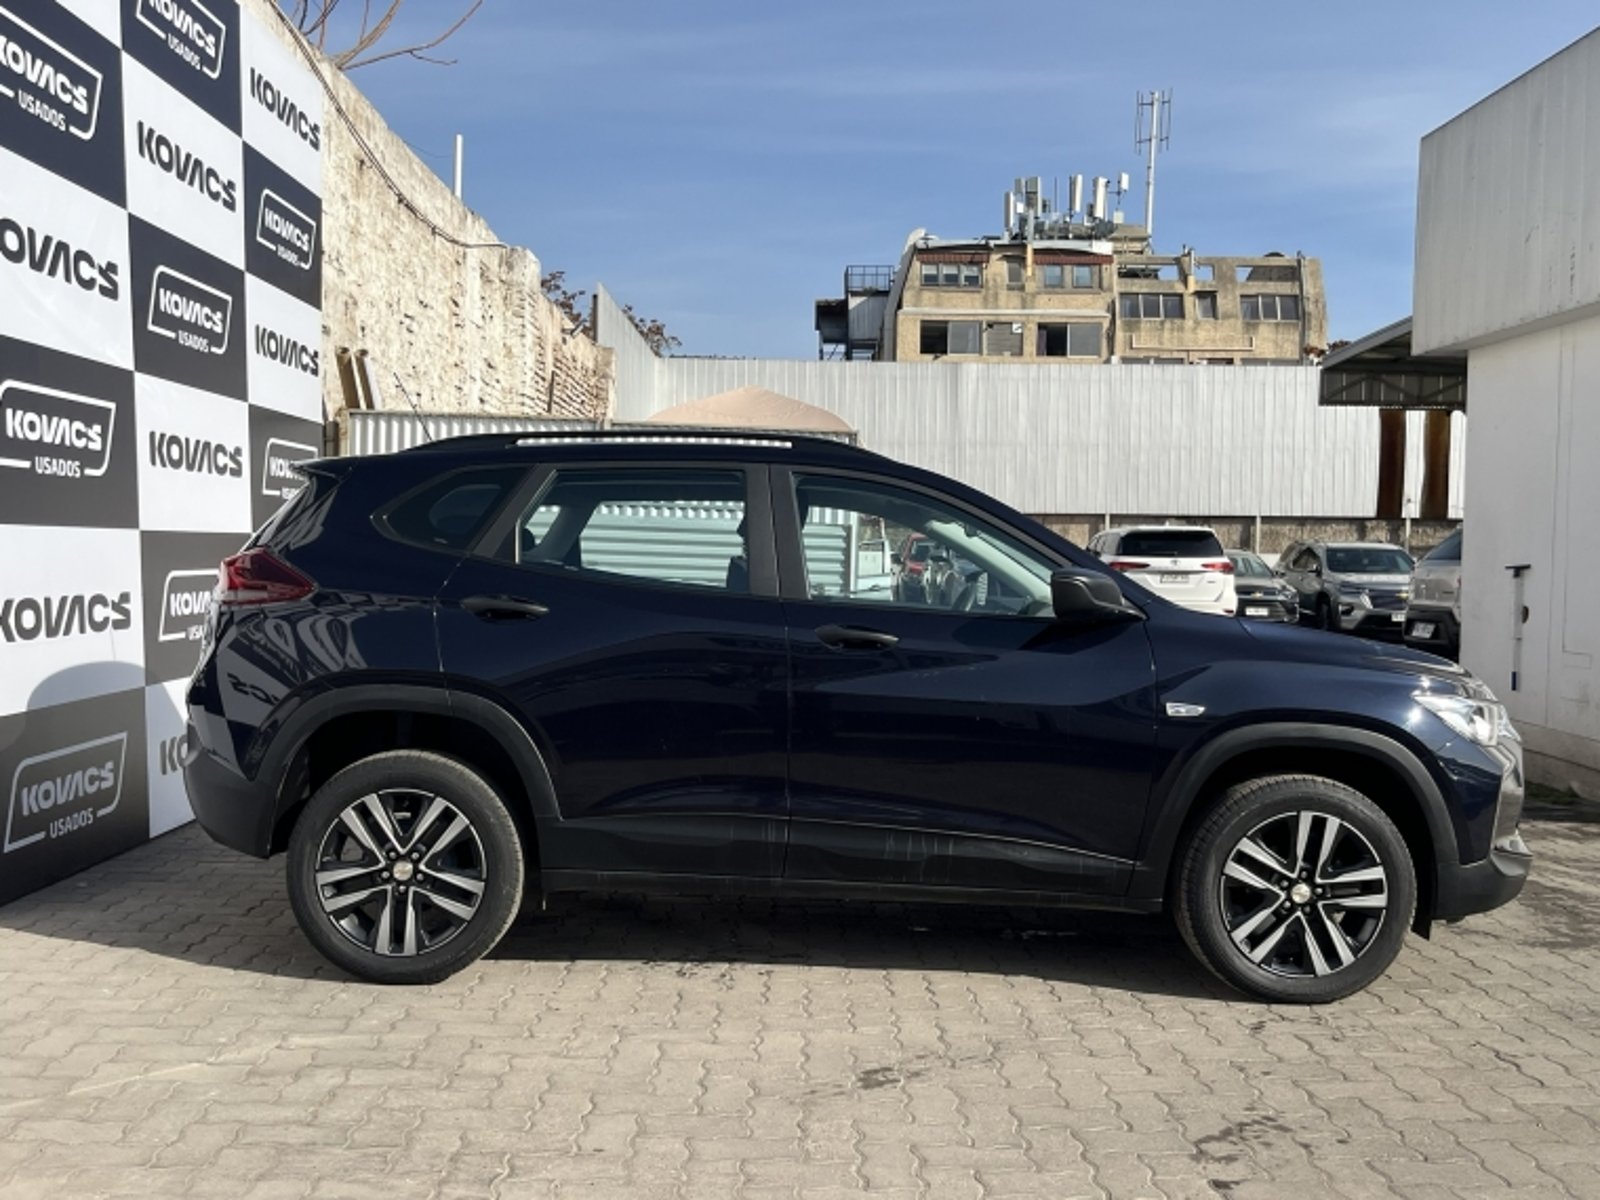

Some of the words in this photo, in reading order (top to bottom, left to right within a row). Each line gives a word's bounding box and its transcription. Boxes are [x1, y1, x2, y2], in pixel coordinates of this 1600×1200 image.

[168, 33, 201, 70] USADOS
[18, 89, 66, 131] USADOS
[249, 67, 320, 151] KOVACS
[137, 120, 236, 212] KOVACS
[264, 207, 310, 252] KOVACS
[159, 287, 224, 333] KOVACS
[177, 332, 209, 353] USADOS
[255, 324, 319, 377] KOVACS
[5, 408, 102, 451] KOVACS
[34, 456, 81, 478] USADOS
[149, 430, 243, 478] KOVACS
[21, 760, 115, 817] KOVACS
[49, 808, 94, 839] USADOS
